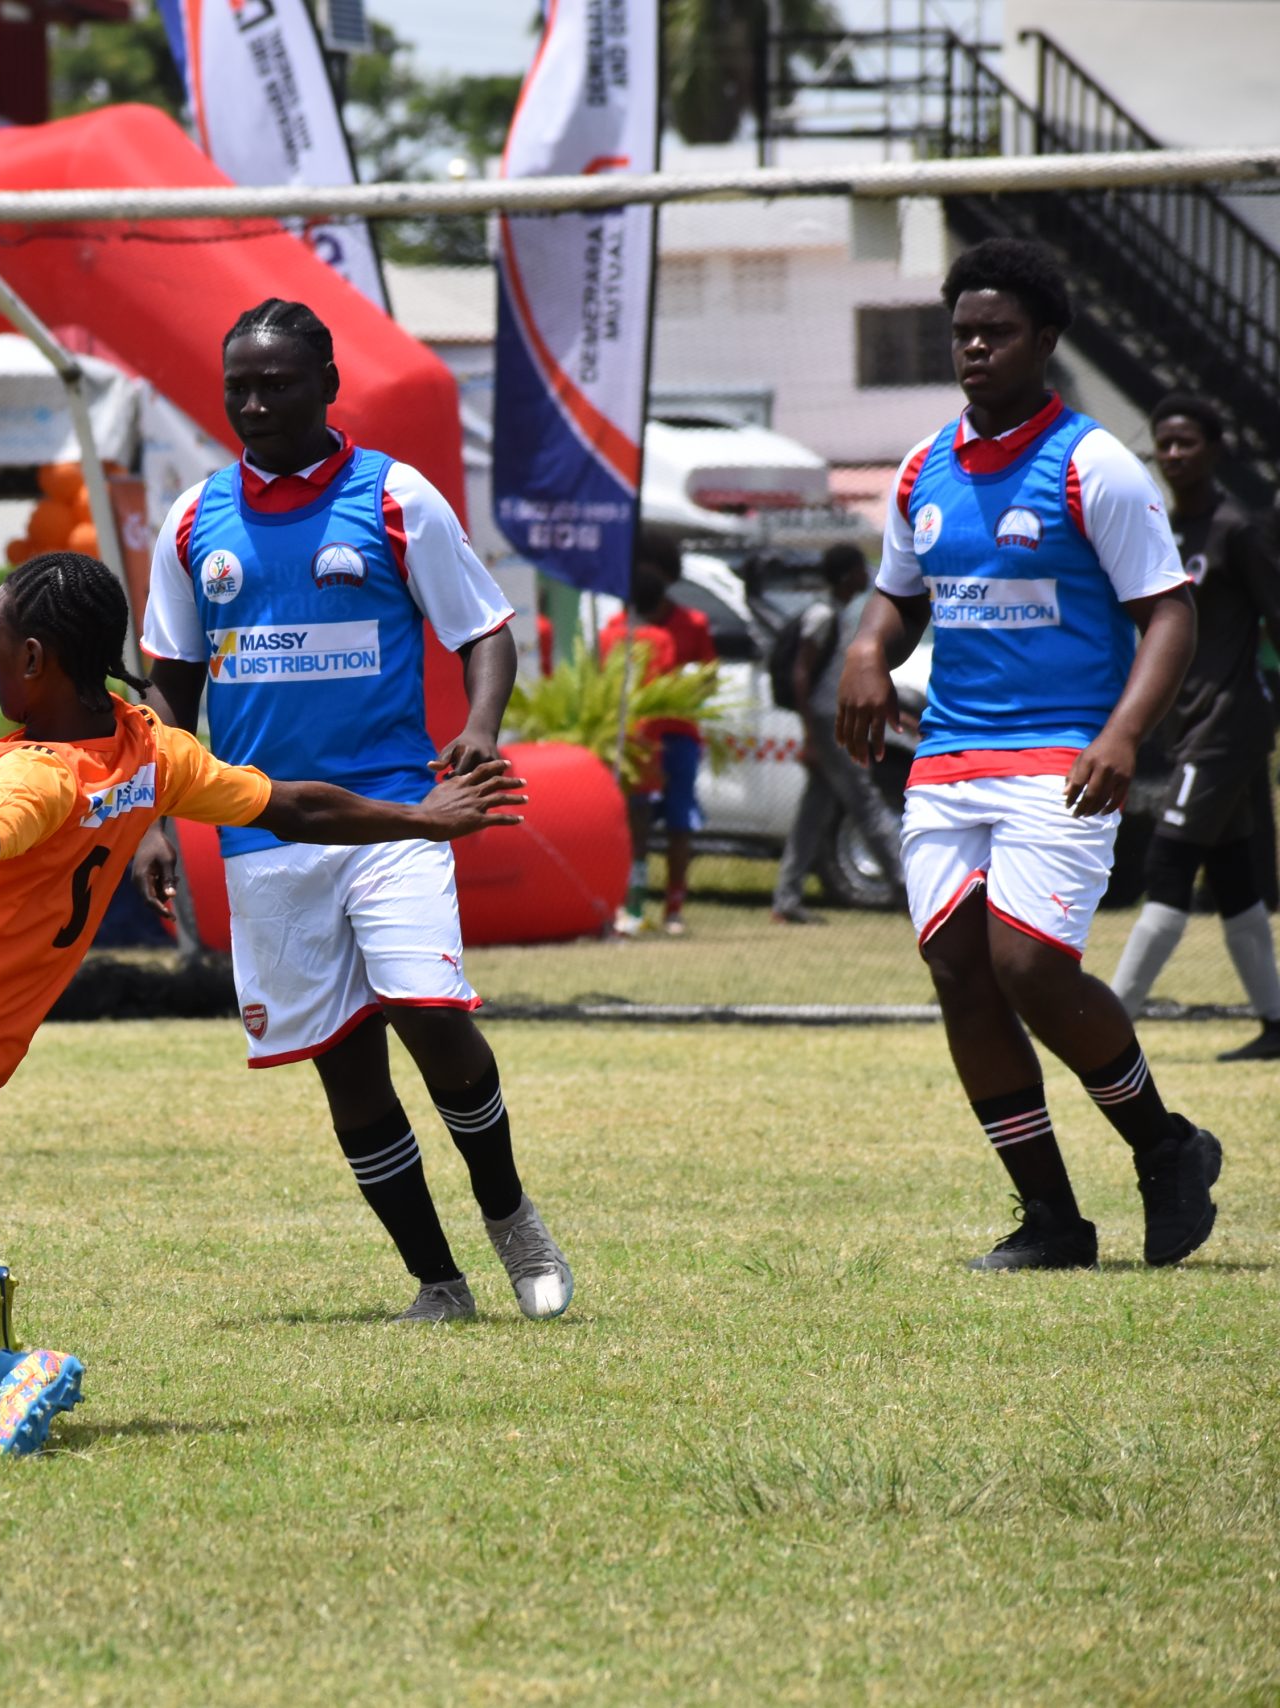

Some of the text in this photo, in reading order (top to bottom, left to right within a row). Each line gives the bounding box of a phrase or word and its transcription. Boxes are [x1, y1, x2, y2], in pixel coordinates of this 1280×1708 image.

[605, 230, 624, 340] MUTUAL
[580, 224, 604, 384] DEMERARA
[995, 534, 1040, 551] PETRA
[314, 573, 364, 590] PETRA
[936, 583, 989, 600] MASSY
[936, 604, 1054, 621] DISTRIBUTION
[240, 632, 308, 651] MASSY
[240, 651, 376, 675] DISTRIBUTION
[1176, 762, 1197, 807] 1
